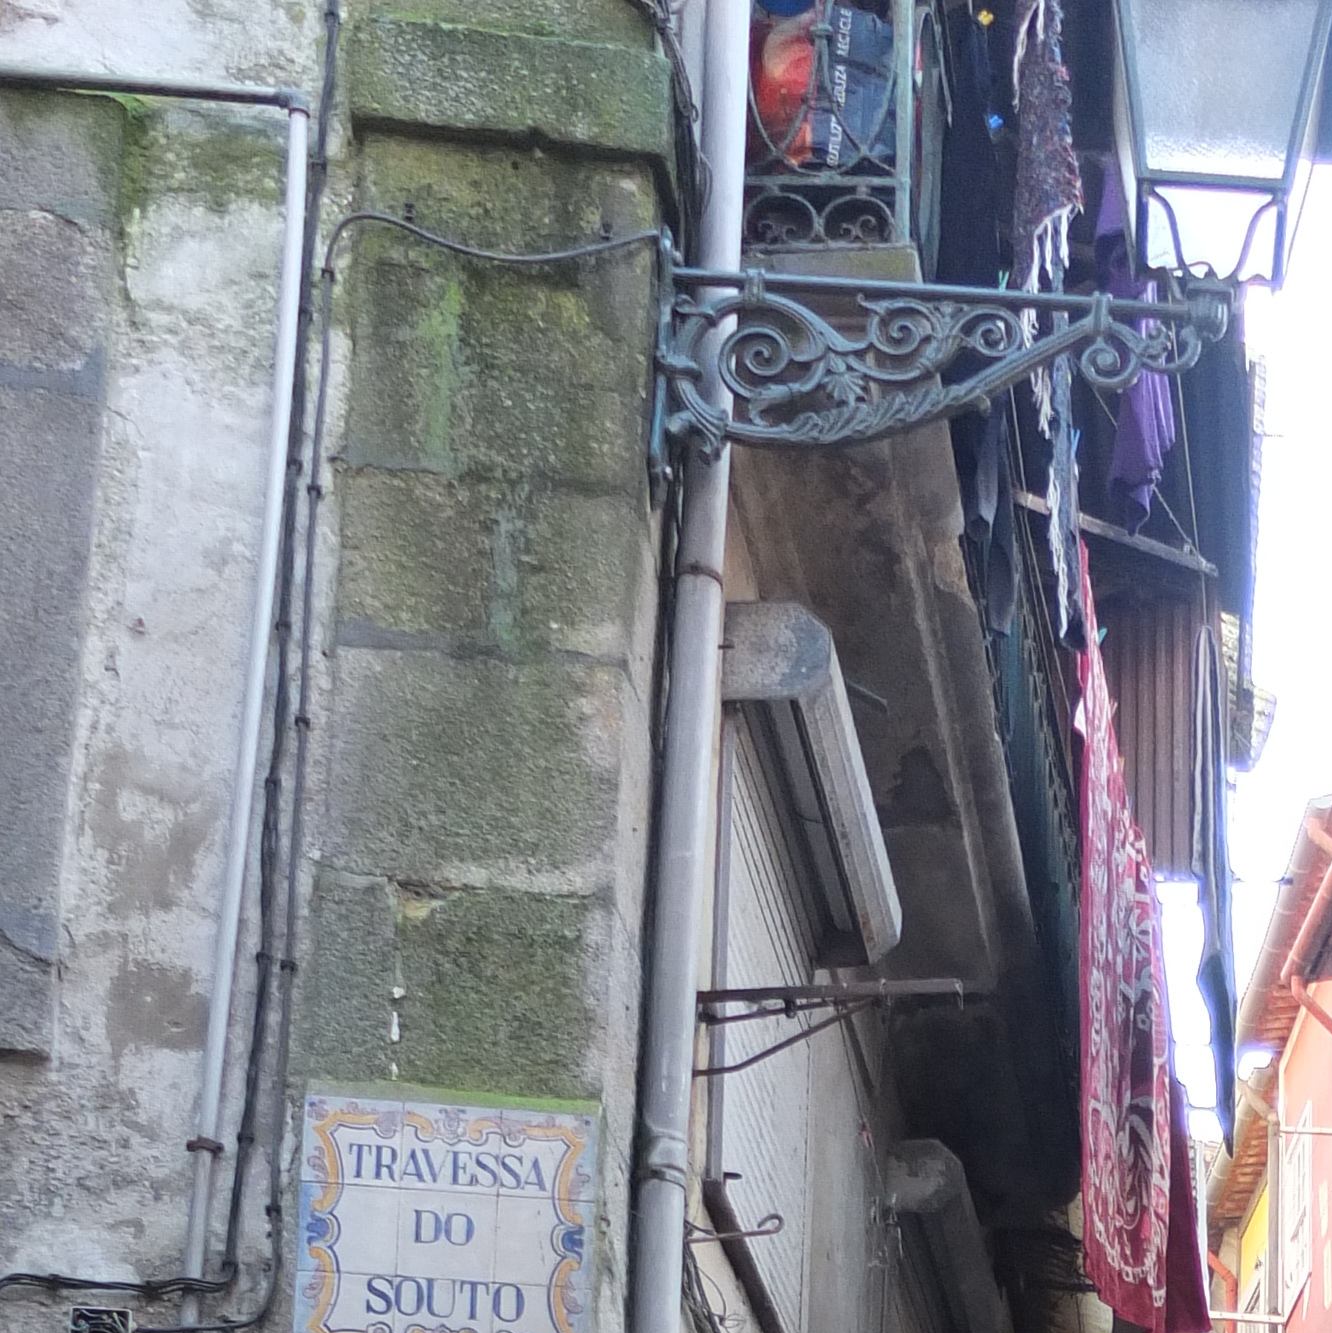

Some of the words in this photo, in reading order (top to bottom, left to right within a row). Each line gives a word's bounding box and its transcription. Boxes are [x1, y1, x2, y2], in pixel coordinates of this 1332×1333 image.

[349, 1142, 548, 1192] TRAVESSA
[413, 1209, 476, 1246] DO
[365, 1275, 526, 1323] SOUTO
